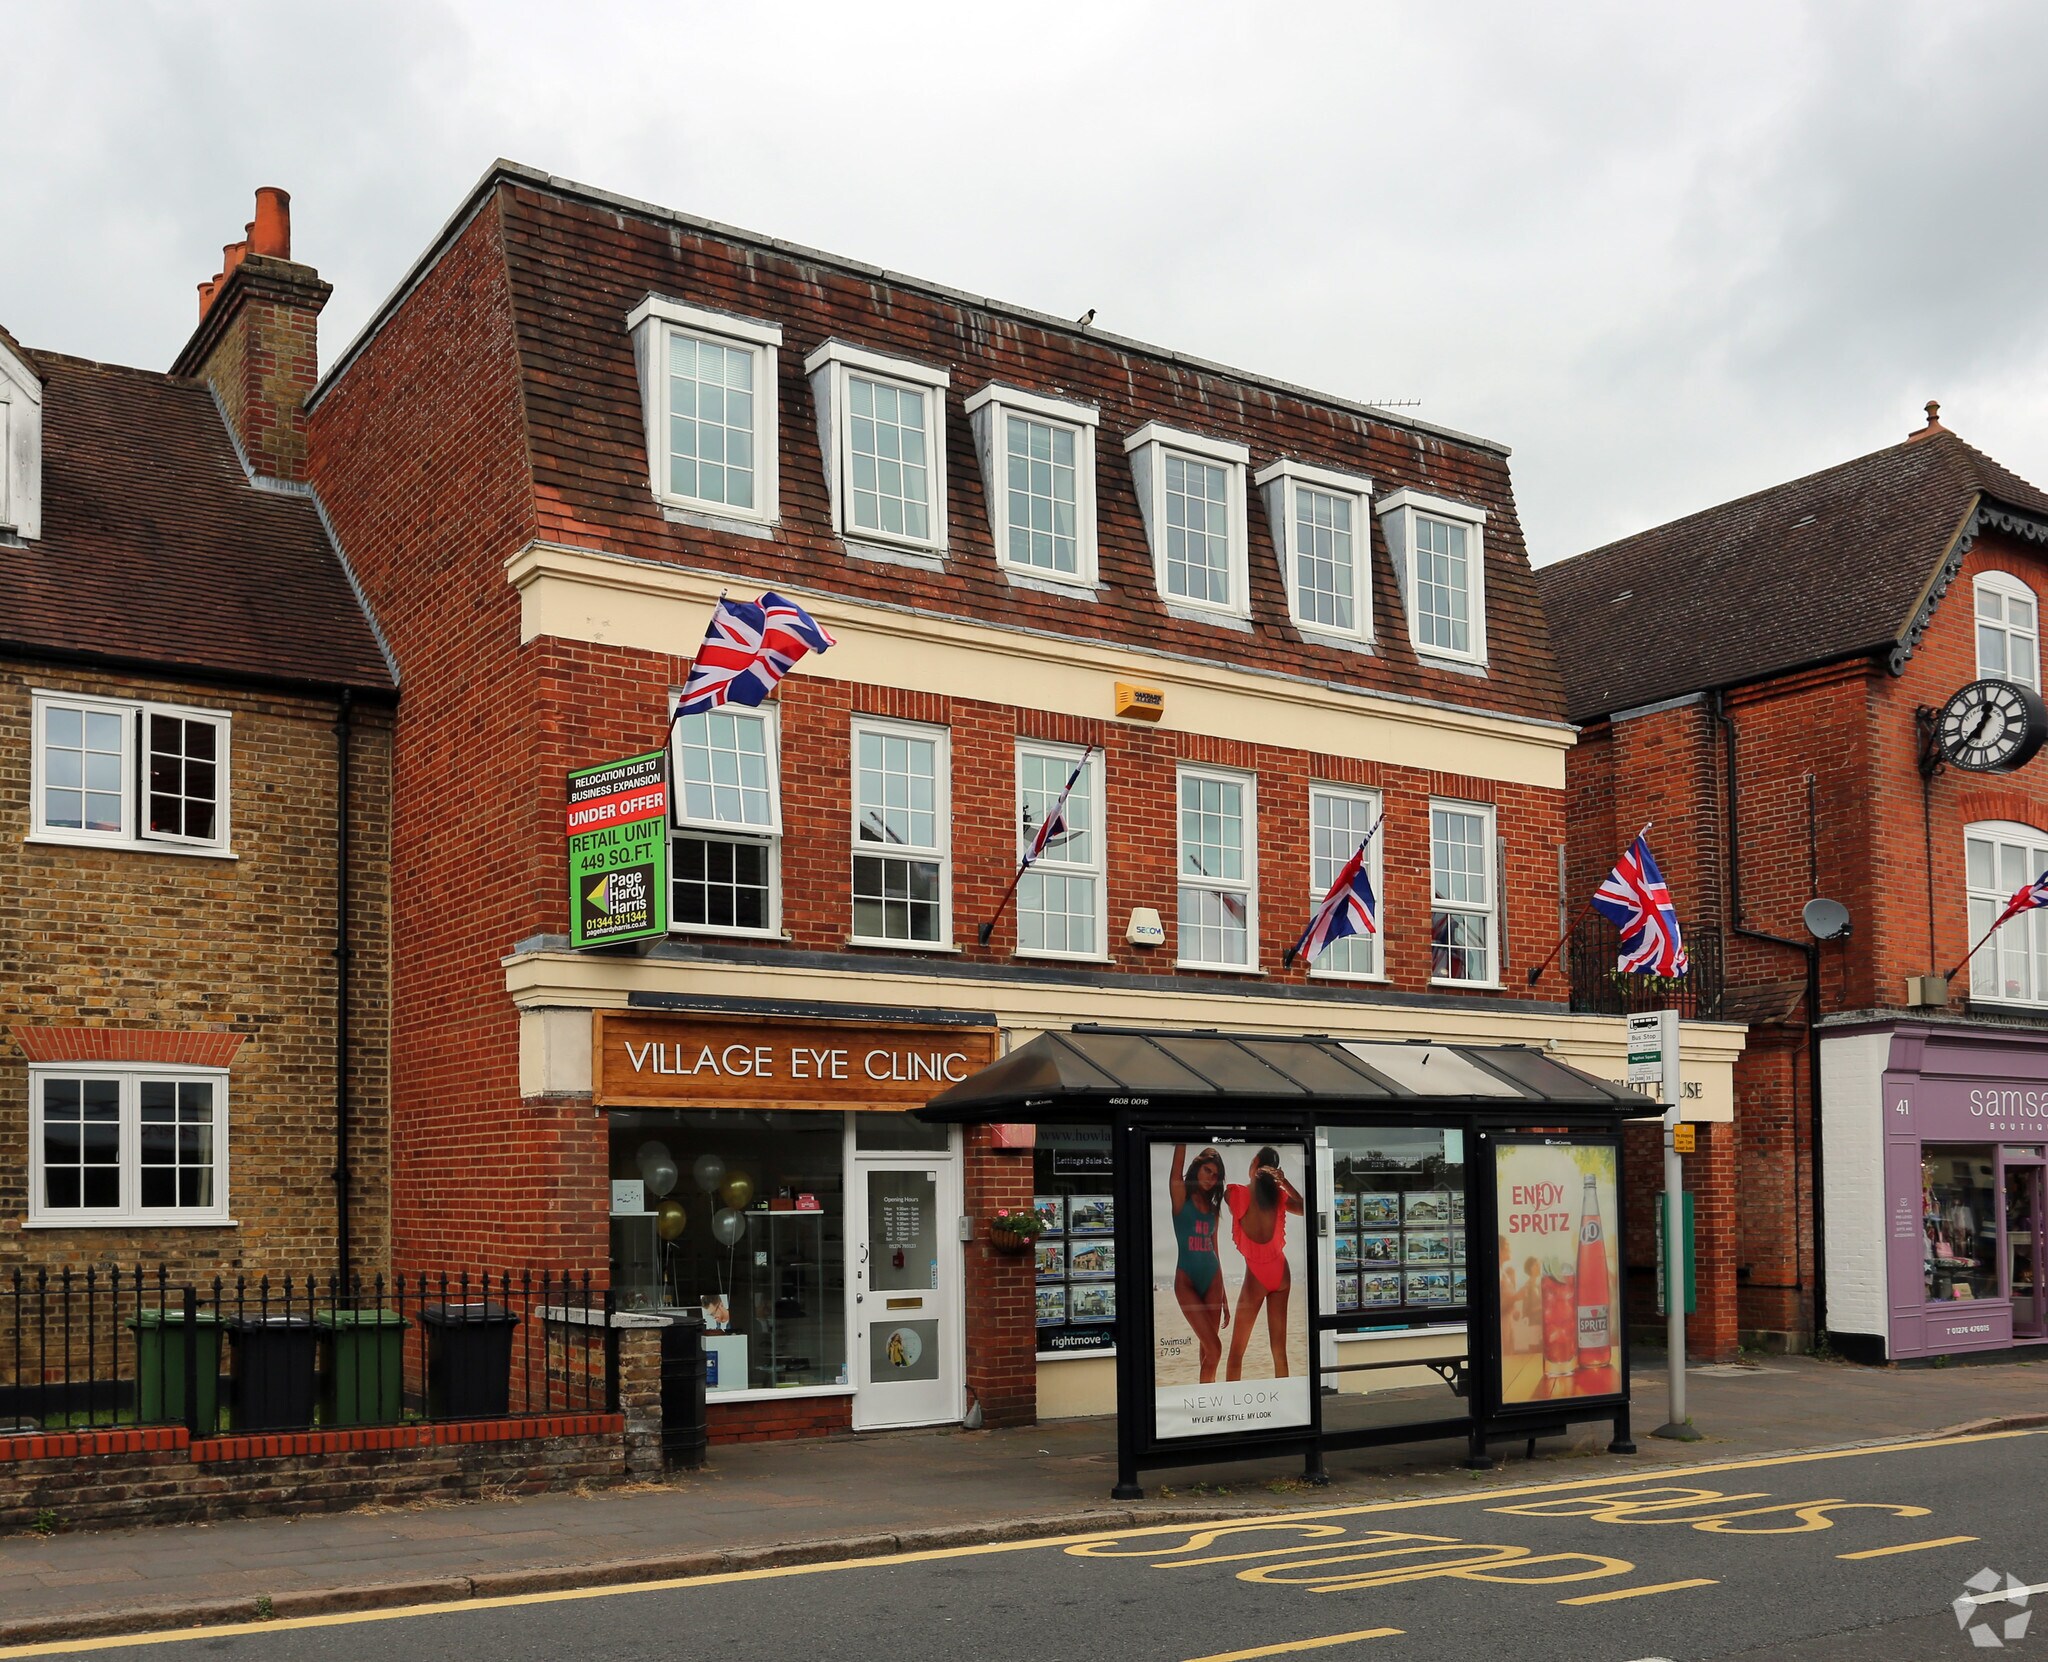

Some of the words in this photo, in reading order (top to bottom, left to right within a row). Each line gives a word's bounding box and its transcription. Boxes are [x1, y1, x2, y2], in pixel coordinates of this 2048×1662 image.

[575, 770, 625, 788] RELOCATION
[626, 762, 644, 776] DUE
[644, 759, 656, 771] TO
[571, 785, 611, 802] BUSINESS
[614, 773, 660, 792] EXPANSION
[569, 806, 616, 827] UNDER
[620, 793, 664, 815] OFFER
[573, 831, 620, 853] RETAIL
[625, 820, 661, 842] UNIT
[581, 855, 605, 871] 449
[609, 843, 653, 866] SQ.FT.
[609, 872, 642, 889] Page
[609, 883, 646, 901] Hardy
[609, 898, 647, 915] Harris
[586, 916, 613, 930] 01344
[615, 910, 647, 926] 311344
[586, 920, 647, 938] pagehardyharris.co.uk
[1136, 925, 1161, 935] SECOM
[1643, 1033, 1656, 1041] Stop
[624, 1041, 773, 1078] VILLAGE
[790, 1048, 848, 1079] EYE
[864, 1049, 968, 1083] CLINIC
[1656, 1081, 1703, 1099] HUSE
[1896, 1100, 1910, 1116] 41
[1990, 1122, 2048, 1131] BOUTIQ
[1056, 1157, 1083, 1166] Lettings
[1085, 1157, 1102, 1165] Sales
[1195, 1219, 1209, 1235] NO
[1508, 1213, 1570, 1235] SPRITZ
[1580, 1319, 1607, 1331] SPRITZ
[1951, 1326, 1969, 1334] 01276
[1051, 1335, 1101, 1348] rightmove
[1160, 1336, 1192, 1346] Swimsuit
[1160, 1347, 1181, 1357] £7.99
[1183, 1395, 1223, 1409] NEW
[1232, 1391, 1279, 1406] LOOK
[1192, 1416, 1200, 1424] MY
[1201, 1415, 1214, 1423] LIFE
[1227, 1413, 1244, 1422] STYLE
[1256, 1411, 1272, 1419] LOOK
[1485, 1486, 1933, 1535] BUS
[1063, 1521, 1636, 1594] STOP
